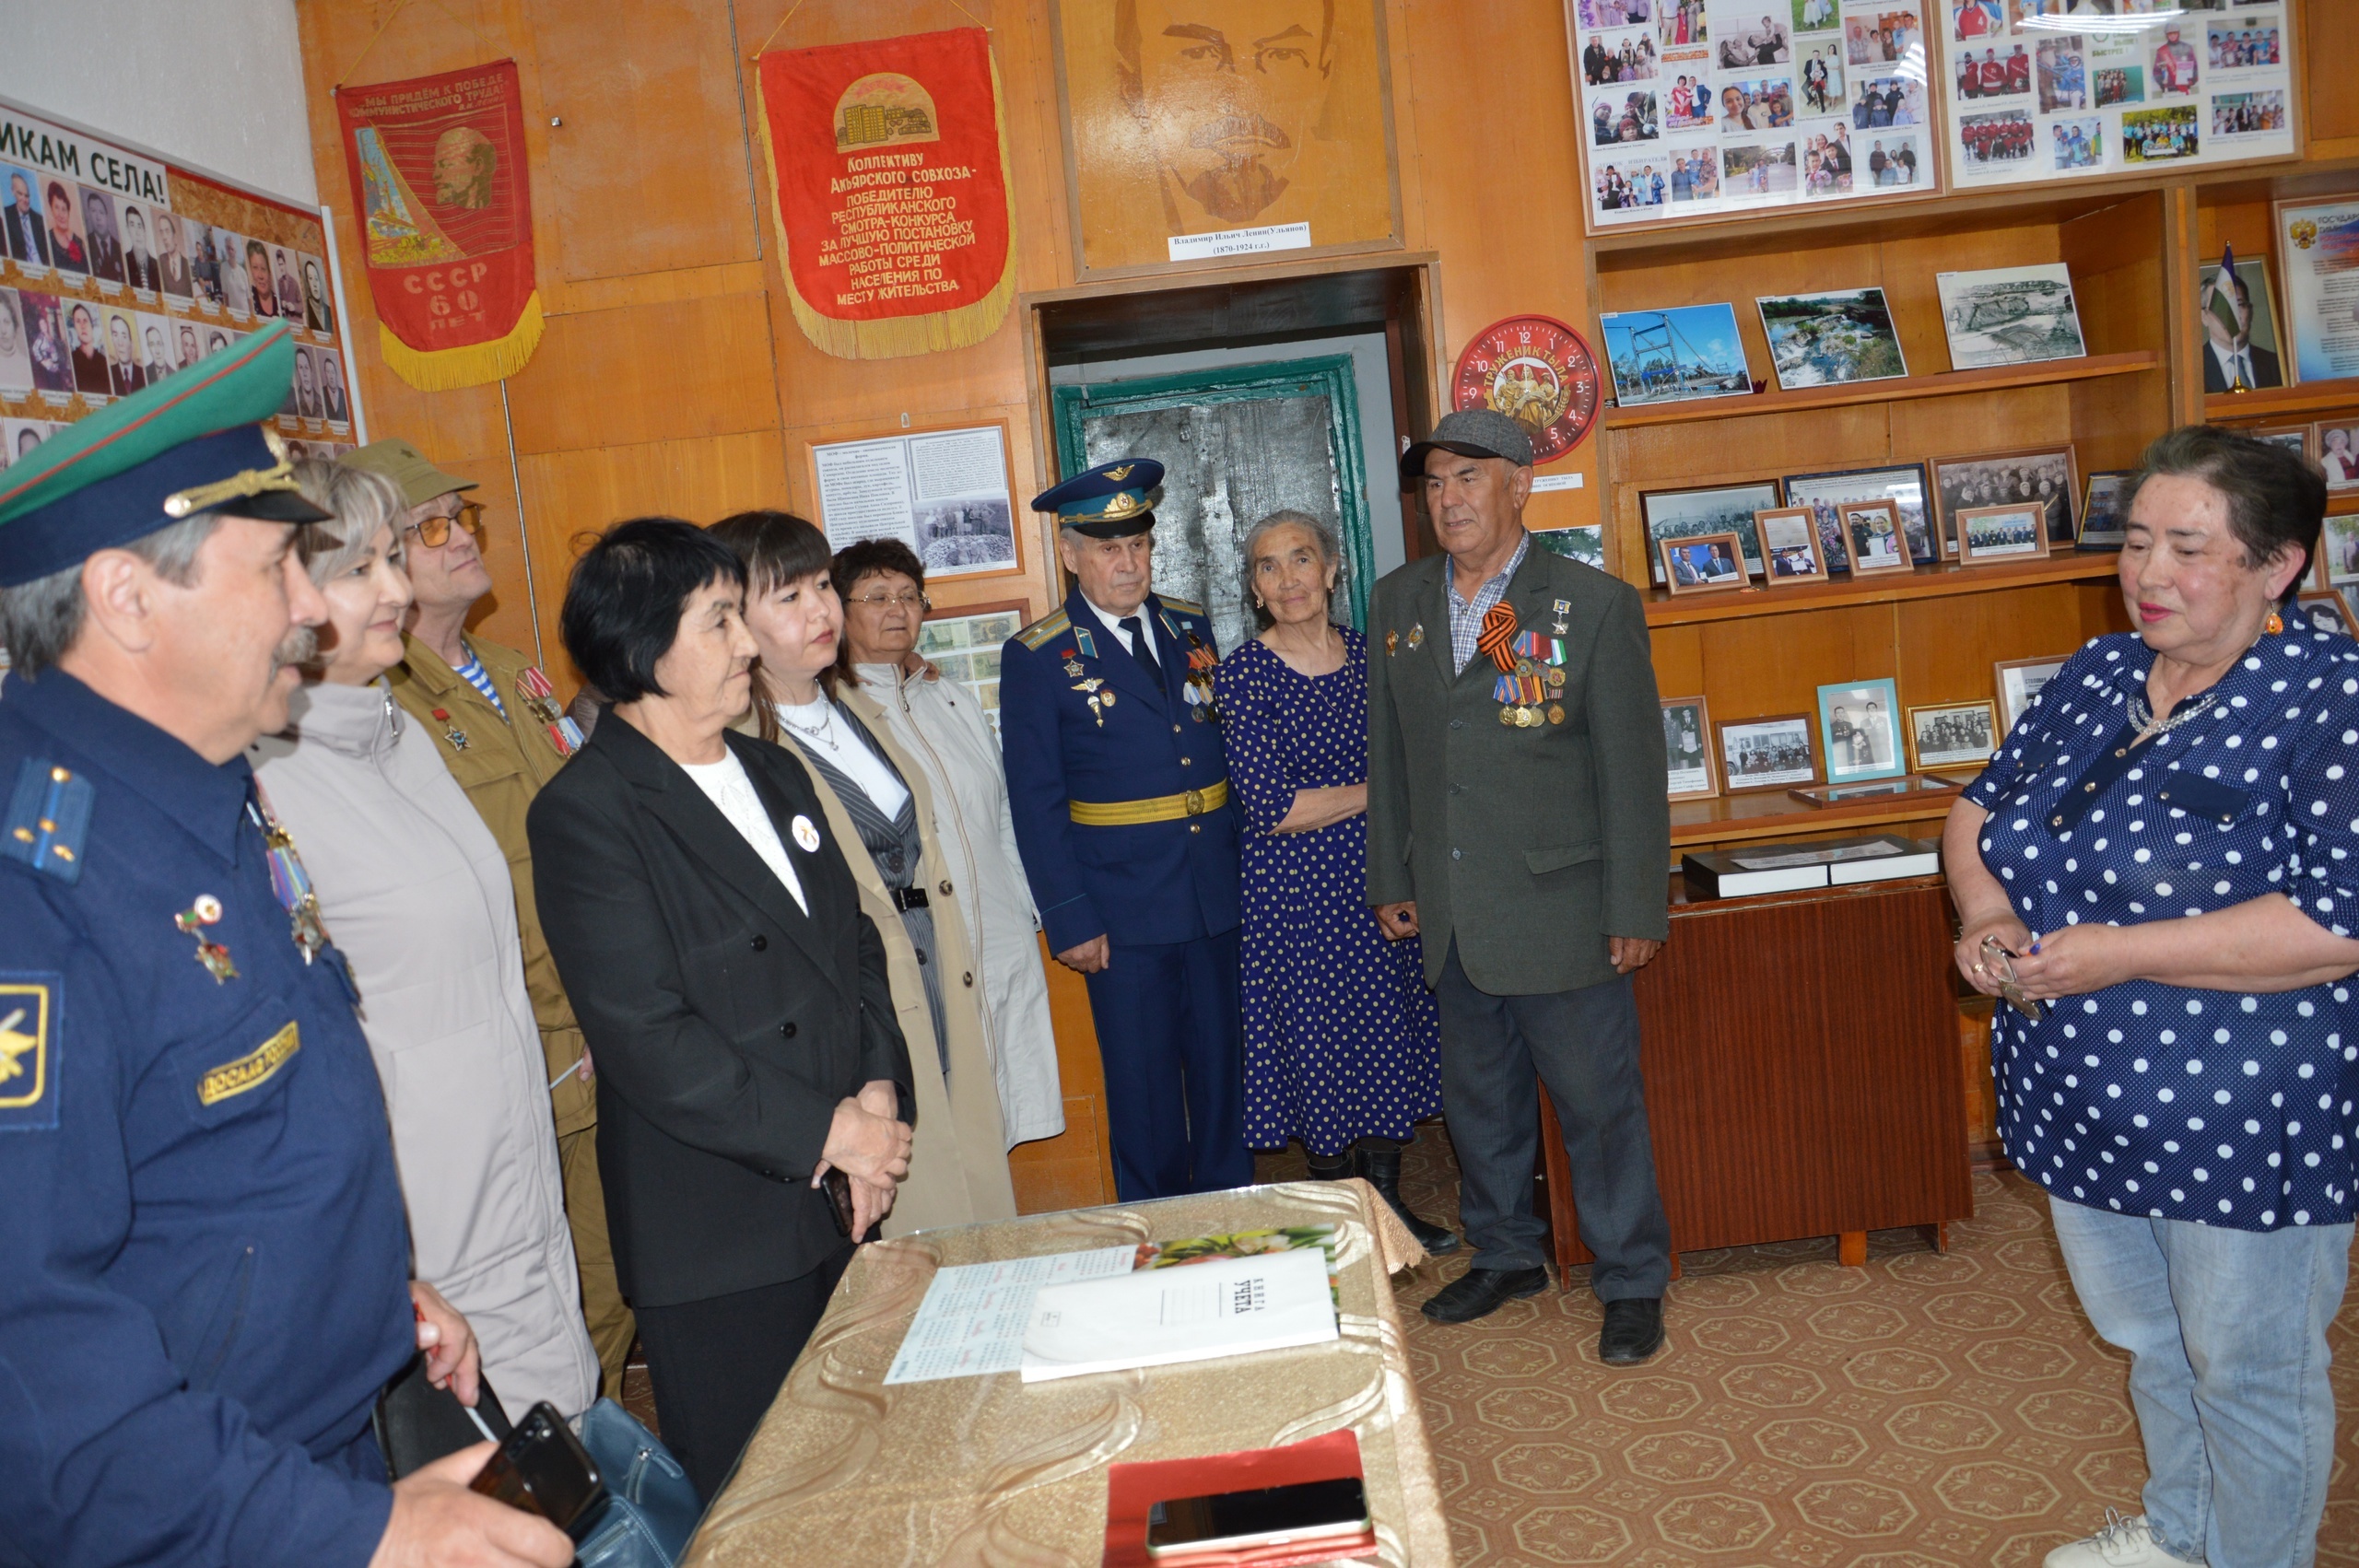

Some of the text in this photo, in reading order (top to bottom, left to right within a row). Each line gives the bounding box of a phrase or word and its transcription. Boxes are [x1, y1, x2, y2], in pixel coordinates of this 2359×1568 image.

[91, 152, 166, 205] СЕЛА!
[846, 186, 933, 207] ПОБЕДИТЕЛЮ
[831, 196, 957, 224] РЕСПУБЛИКАНСКОГО
[840, 211, 956, 235] СМОТРА-КОНКУРСА
[821, 220, 973, 252] ЗА ЛУЧШУЮ ПОСТАНОВКУ
[1174, 236, 1214, 245] Владимир
[1215, 232, 1240, 240] Ильич
[818, 230, 976, 267] МАССОВО-ПОЛИТИЧЕСКОЙ
[849, 253, 941, 275] РАБОТЫ СРЕДИ
[403, 262, 487, 294] СССР
[851, 267, 943, 290] НАСЕЛЕНИЯ ПО
[429, 289, 478, 316] 60
[837, 279, 958, 306] МЕСТУ ЖИТЕЛЬСТВА
[429, 310, 487, 331] ЛЕТ
[1496, 340, 1505, 353] 11
[1519, 332, 1531, 344] 12
[1476, 360, 1488, 372] 10
[1484, 345, 1569, 387] ТРУЖЕНИК ТЫЛА
[1567, 356, 1576, 368] 2
[1469, 388, 1477, 399] 9
[1576, 381, 1584, 393] 3
[1568, 409, 1578, 421] 4
[1550, 427, 1558, 439] 5
[1234, 1280, 1251, 1314] УЧЕТА
